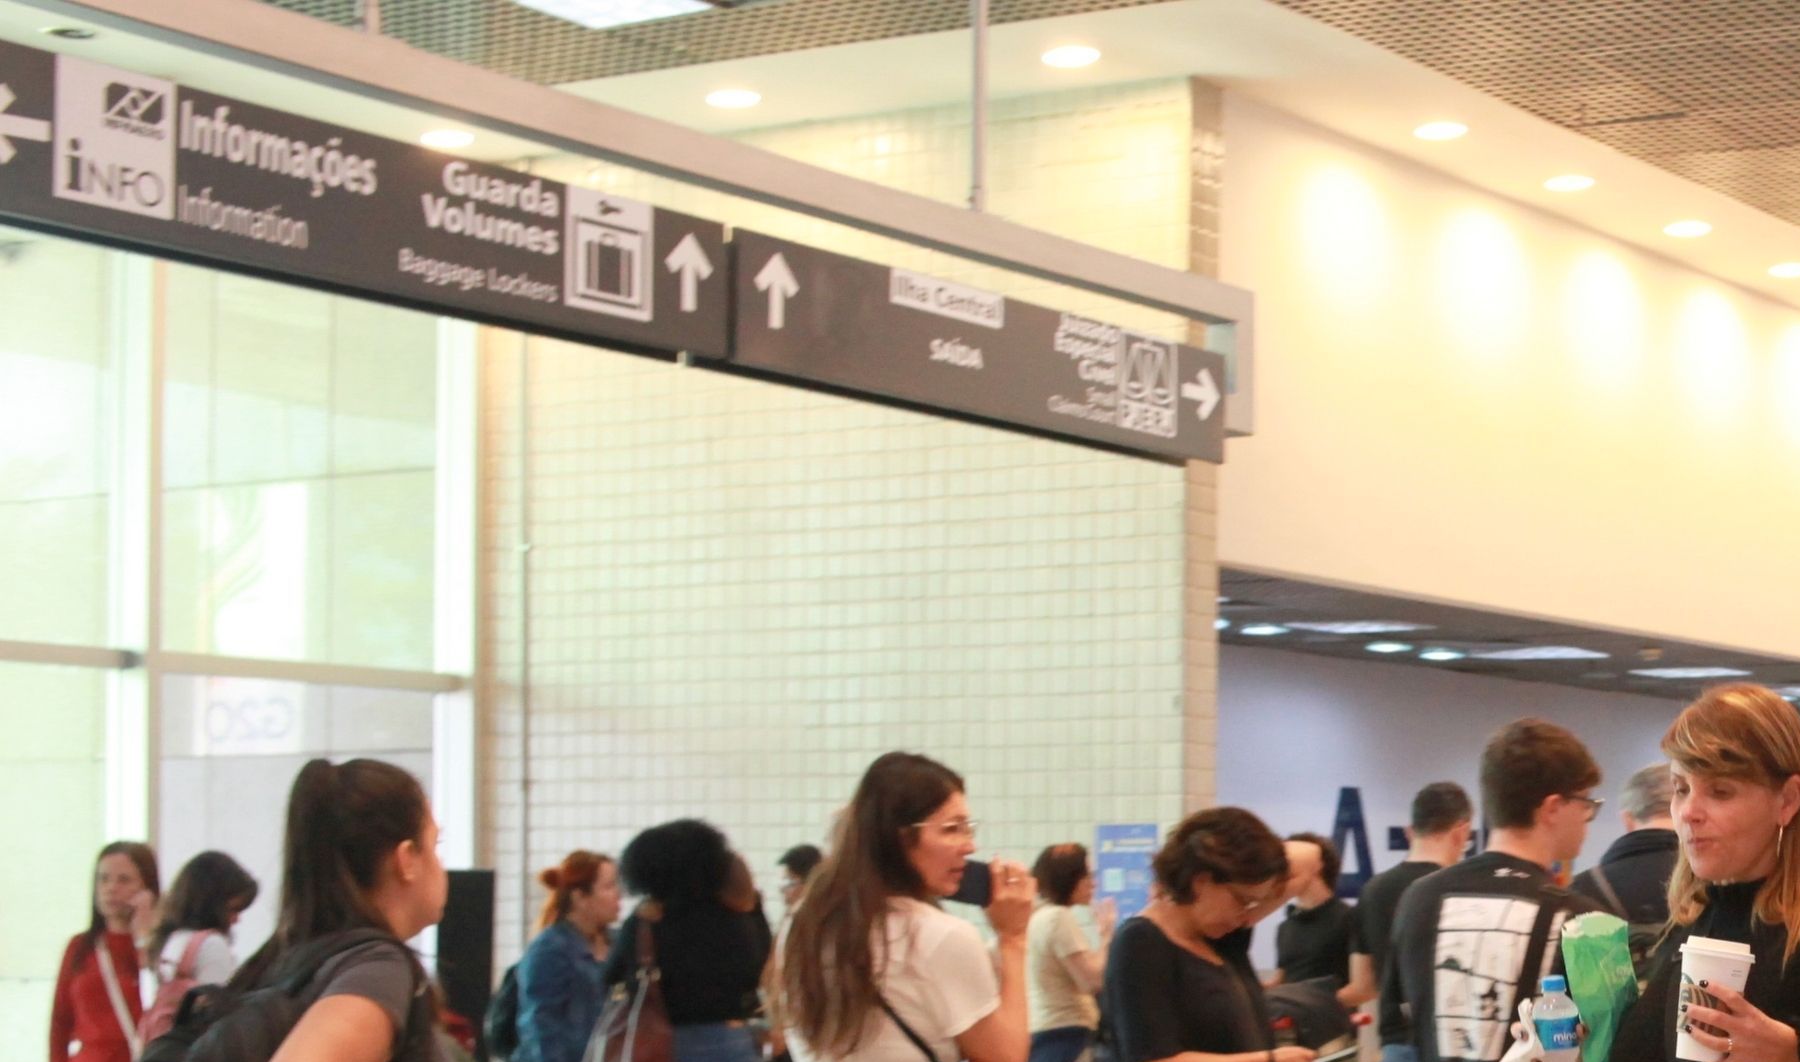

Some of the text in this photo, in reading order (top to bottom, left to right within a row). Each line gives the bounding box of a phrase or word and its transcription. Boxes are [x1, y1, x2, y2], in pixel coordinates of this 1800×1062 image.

[180, 100, 378, 198] Informações
[178, 184, 309, 249] Information
[441, 161, 560, 218] Guarda
[421, 193, 560, 255] Volumes
[397, 247, 559, 303] Baggage Lockers
[933, 285, 998, 320] Central
